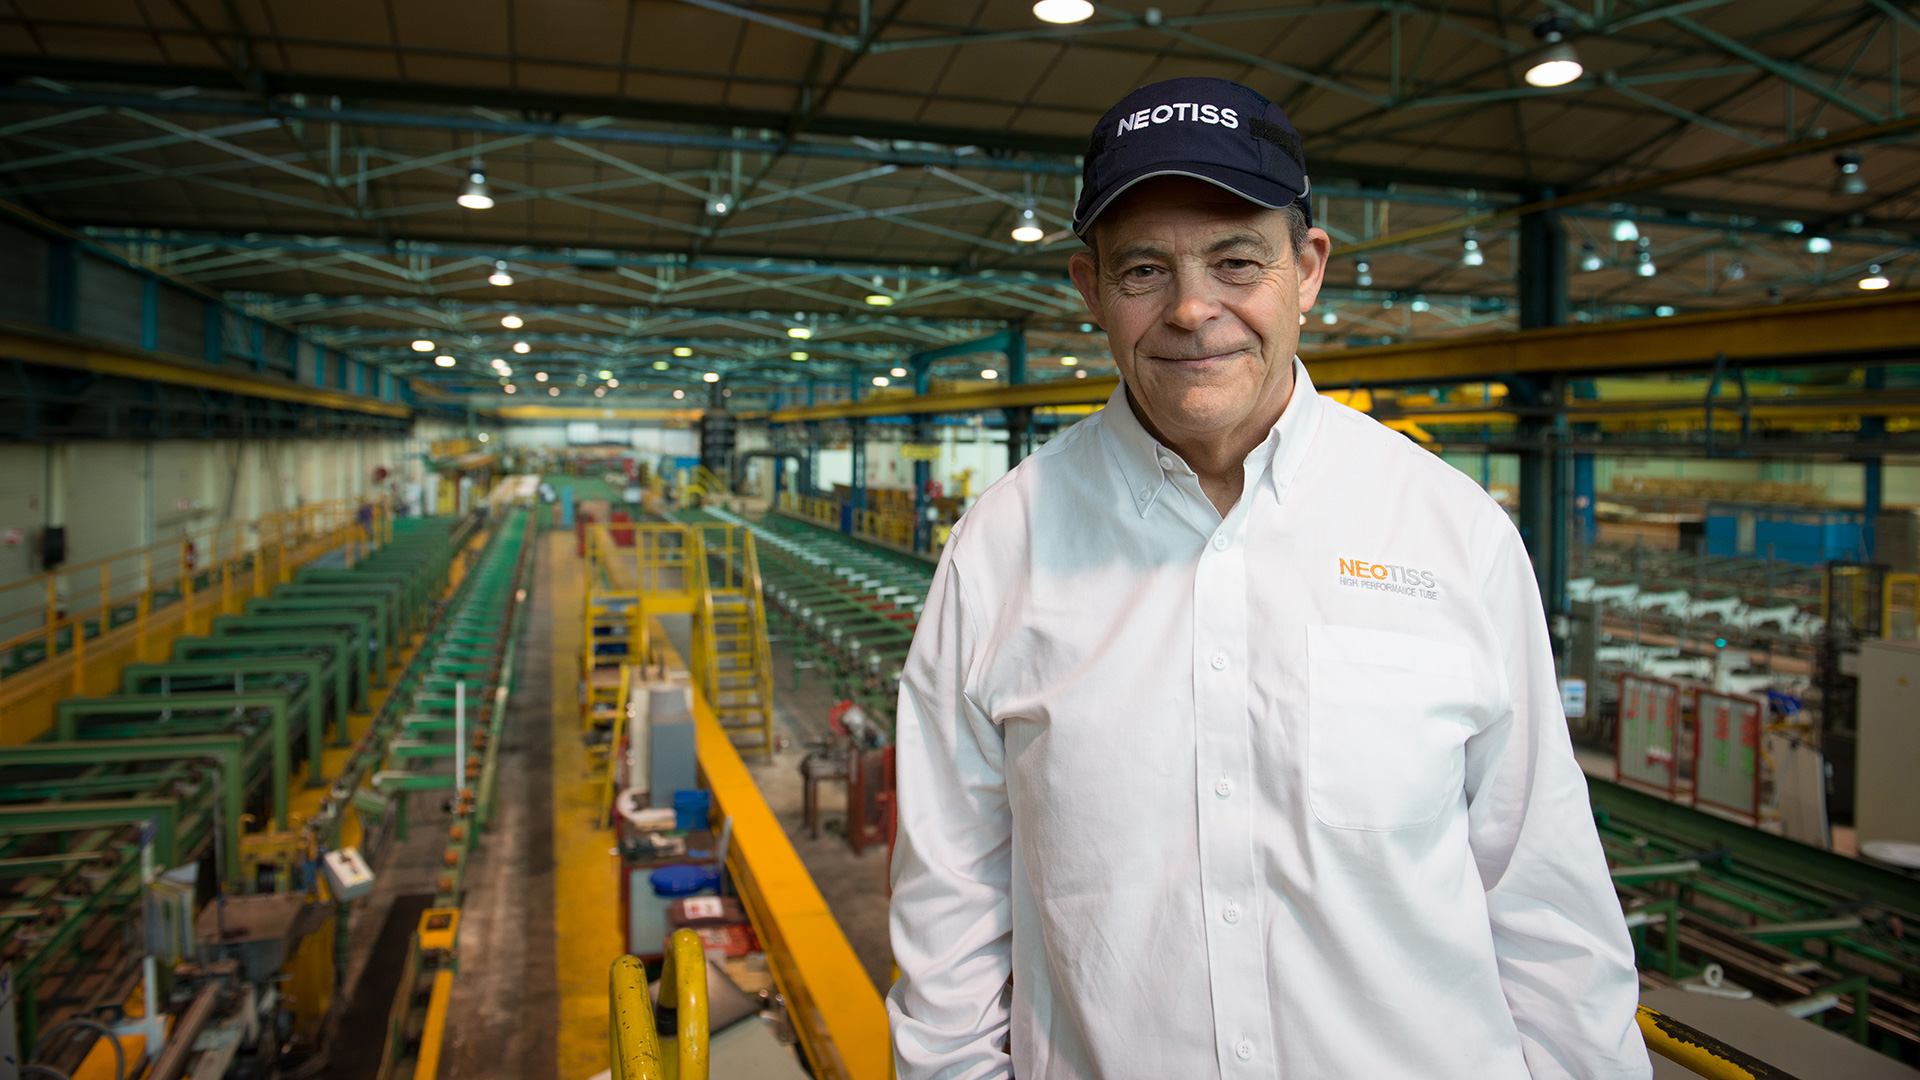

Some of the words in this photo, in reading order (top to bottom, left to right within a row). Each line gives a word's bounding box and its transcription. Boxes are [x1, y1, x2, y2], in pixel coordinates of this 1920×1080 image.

[1116, 102, 1239, 137] NEOTISS
[1339, 557, 1436, 588] NEOTISS
[1339, 576, 1359, 588] HIGH
[1361, 580, 1417, 597] PERFORMANCE
[1418, 588, 1438, 600] TUBE
